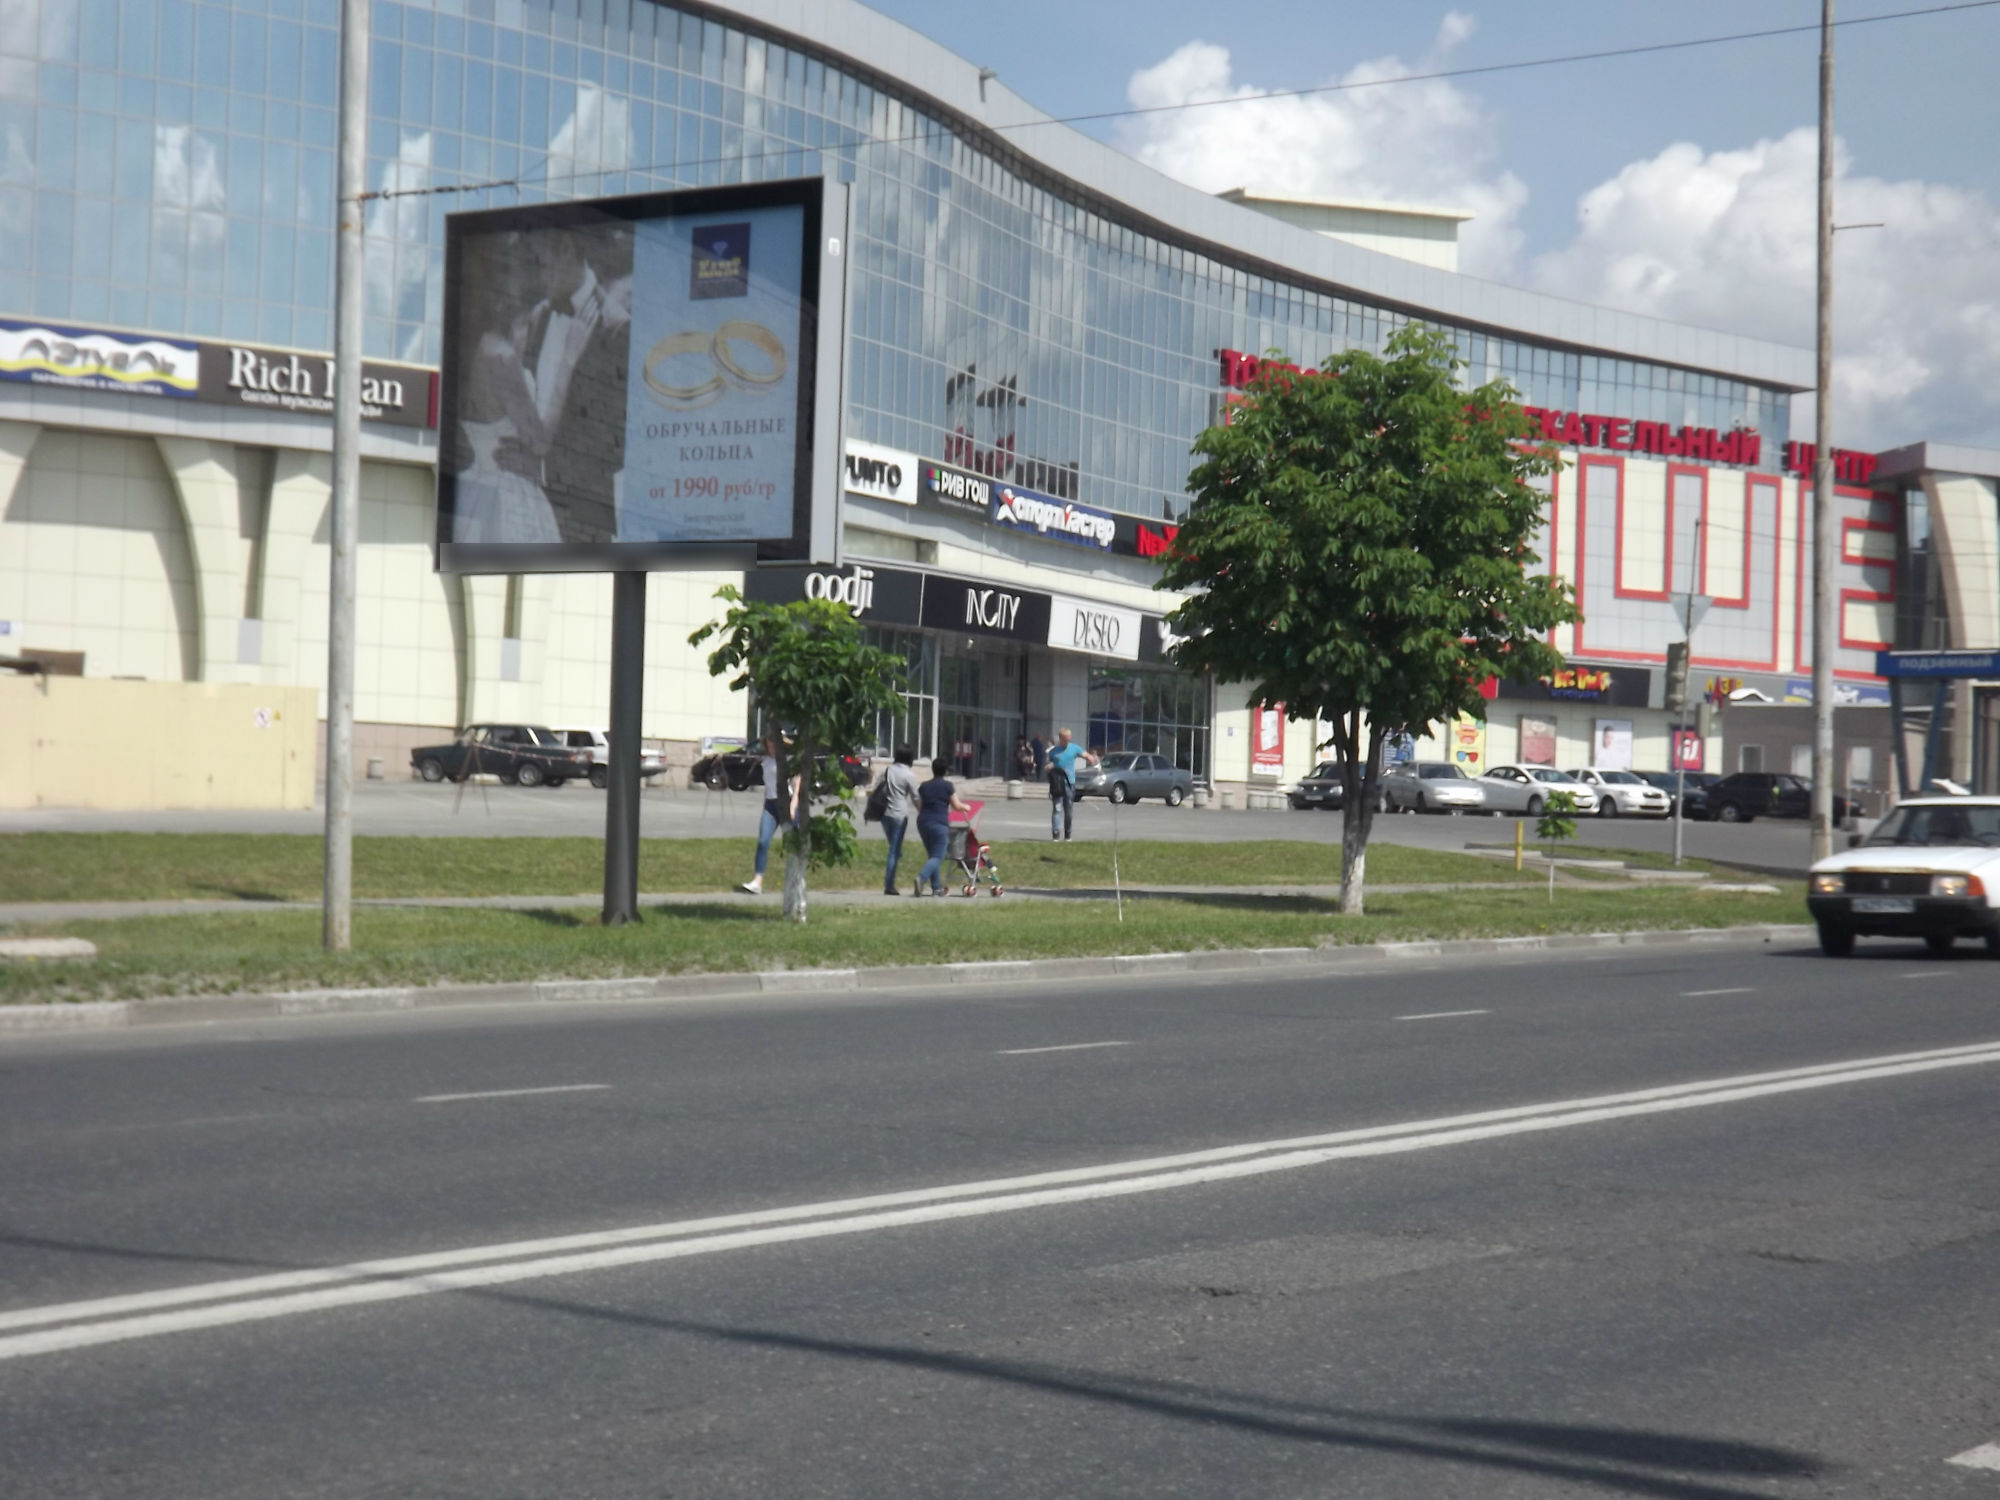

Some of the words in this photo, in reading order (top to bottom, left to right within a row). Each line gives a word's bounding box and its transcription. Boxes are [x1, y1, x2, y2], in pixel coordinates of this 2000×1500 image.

[229, 347, 312, 396] Rich
[646, 418, 787, 439] ОБРУЧАЛЬНЫЕ
[680, 445, 754, 462] КОЛЬЦА
[649, 485, 666, 499] от
[673, 476, 719, 499] 1990
[723, 480, 776, 503] руб/гр
[804, 565, 874, 617] oodji
[965, 588, 1021, 631] INCITY
[1073, 608, 1120, 652] DESEO
